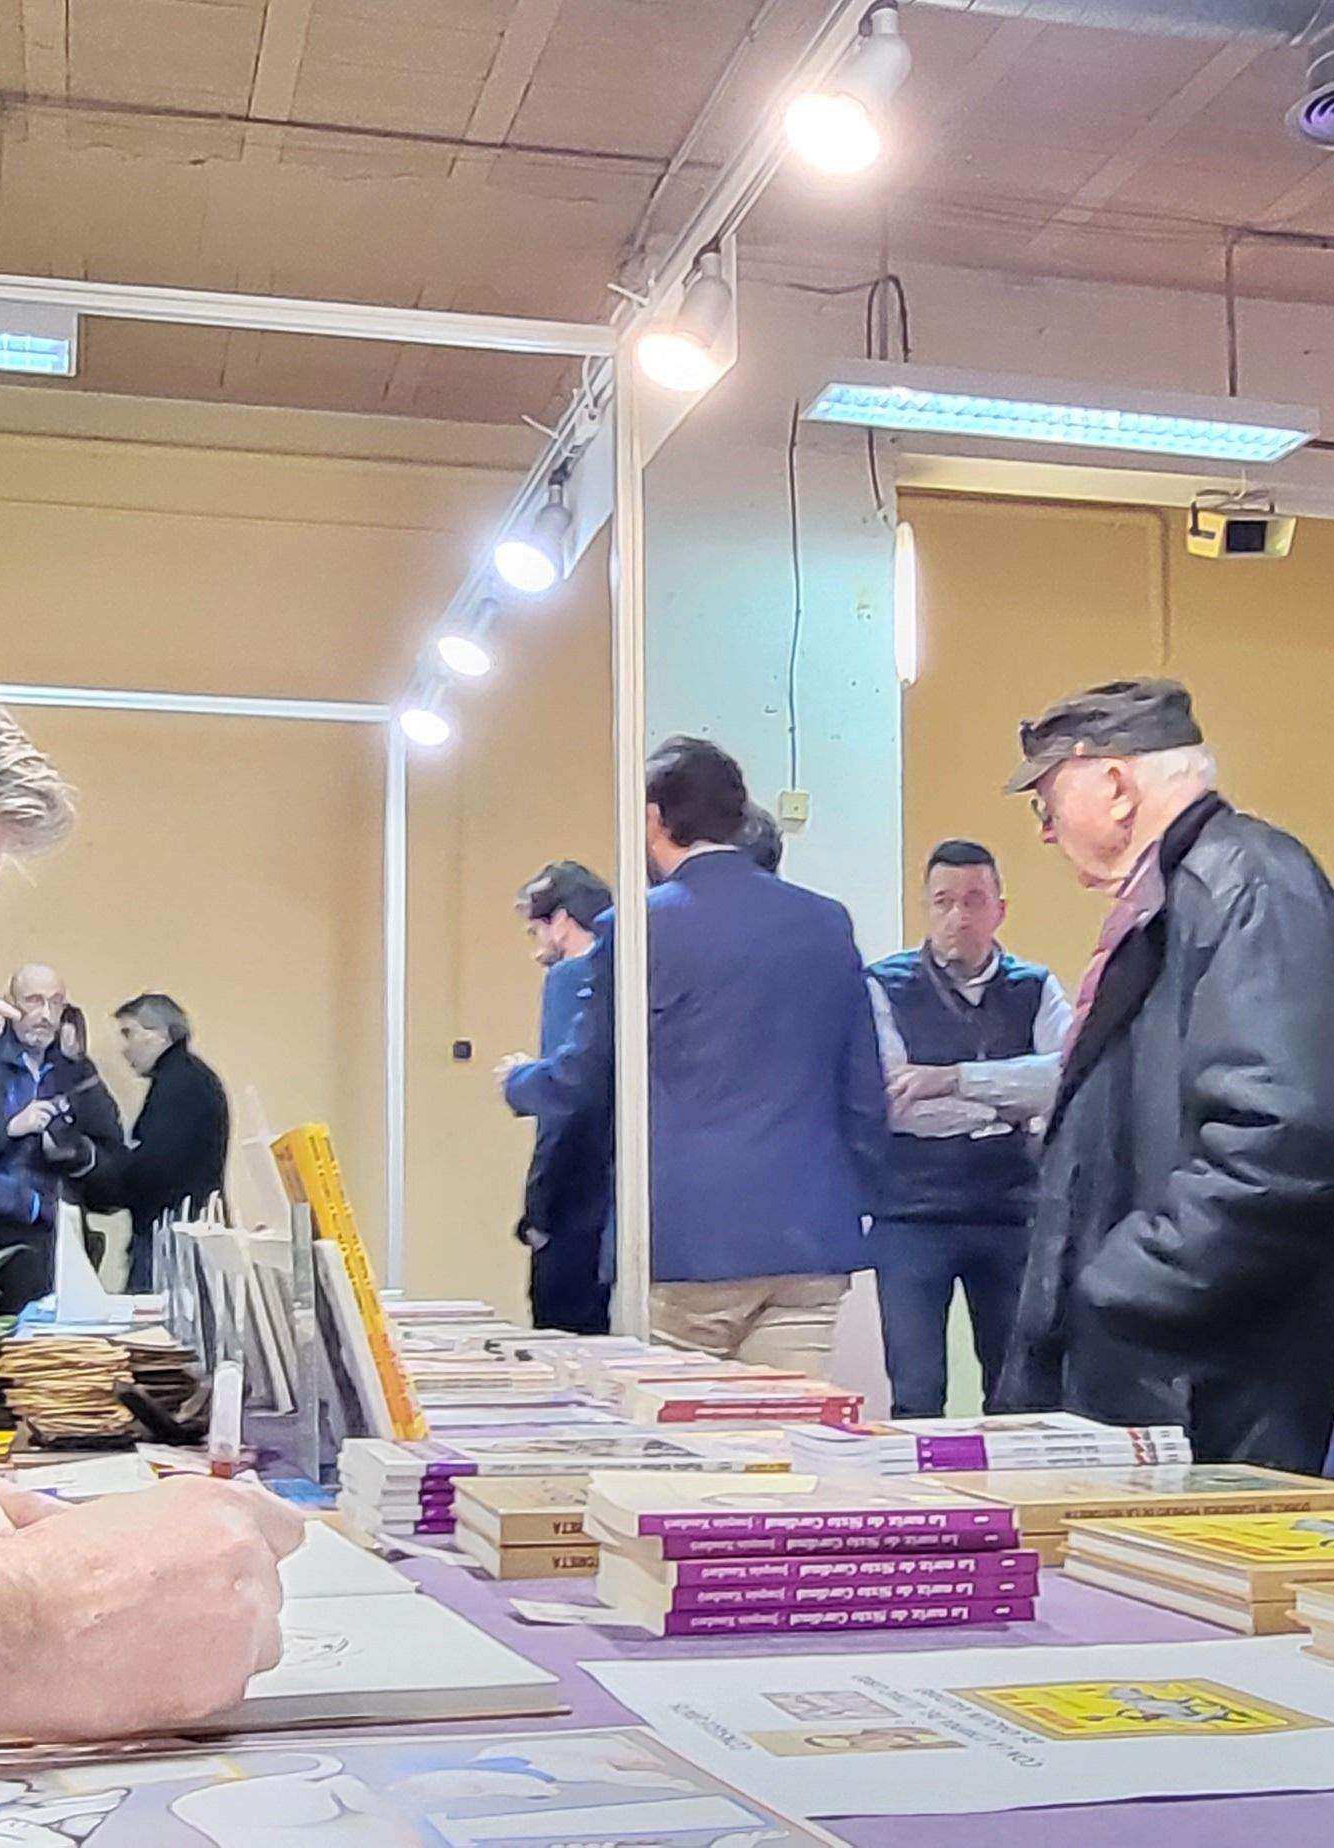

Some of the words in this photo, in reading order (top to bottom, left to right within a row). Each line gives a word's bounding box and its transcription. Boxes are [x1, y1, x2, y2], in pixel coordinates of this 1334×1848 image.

[930, 1514, 946, 1527] La
[958, 1559, 975, 1571] La
[957, 1583, 973, 1595] La
[951, 1607, 968, 1619] La
